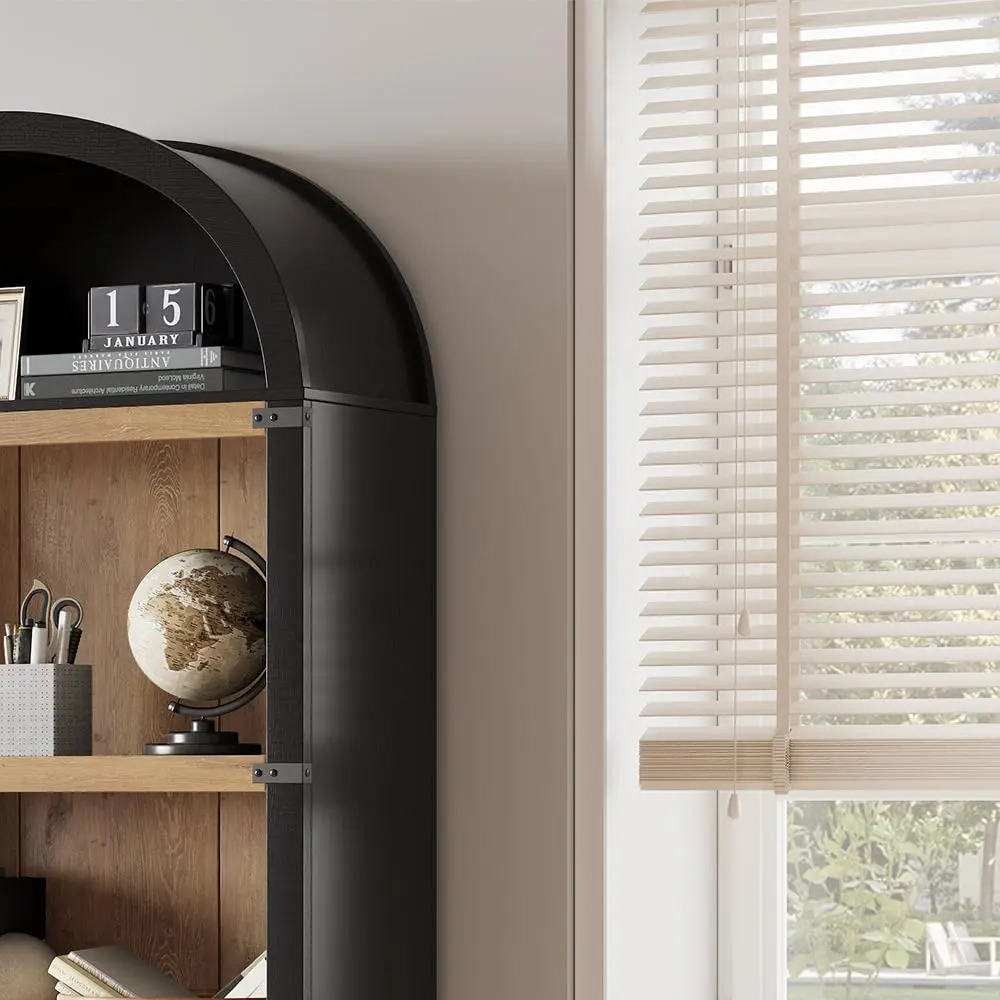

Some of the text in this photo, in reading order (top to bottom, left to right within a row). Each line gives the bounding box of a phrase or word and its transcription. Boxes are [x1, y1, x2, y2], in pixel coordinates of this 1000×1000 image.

[106, 288, 182, 327] 1 5
[204, 288, 216, 326] 6
[103, 333, 180, 348] JANUARY
[71, 354, 171, 372] ANTIQUAIRES
[158, 372, 205, 382] Virginia McLeod
[140, 384, 181, 393] Contemporary
